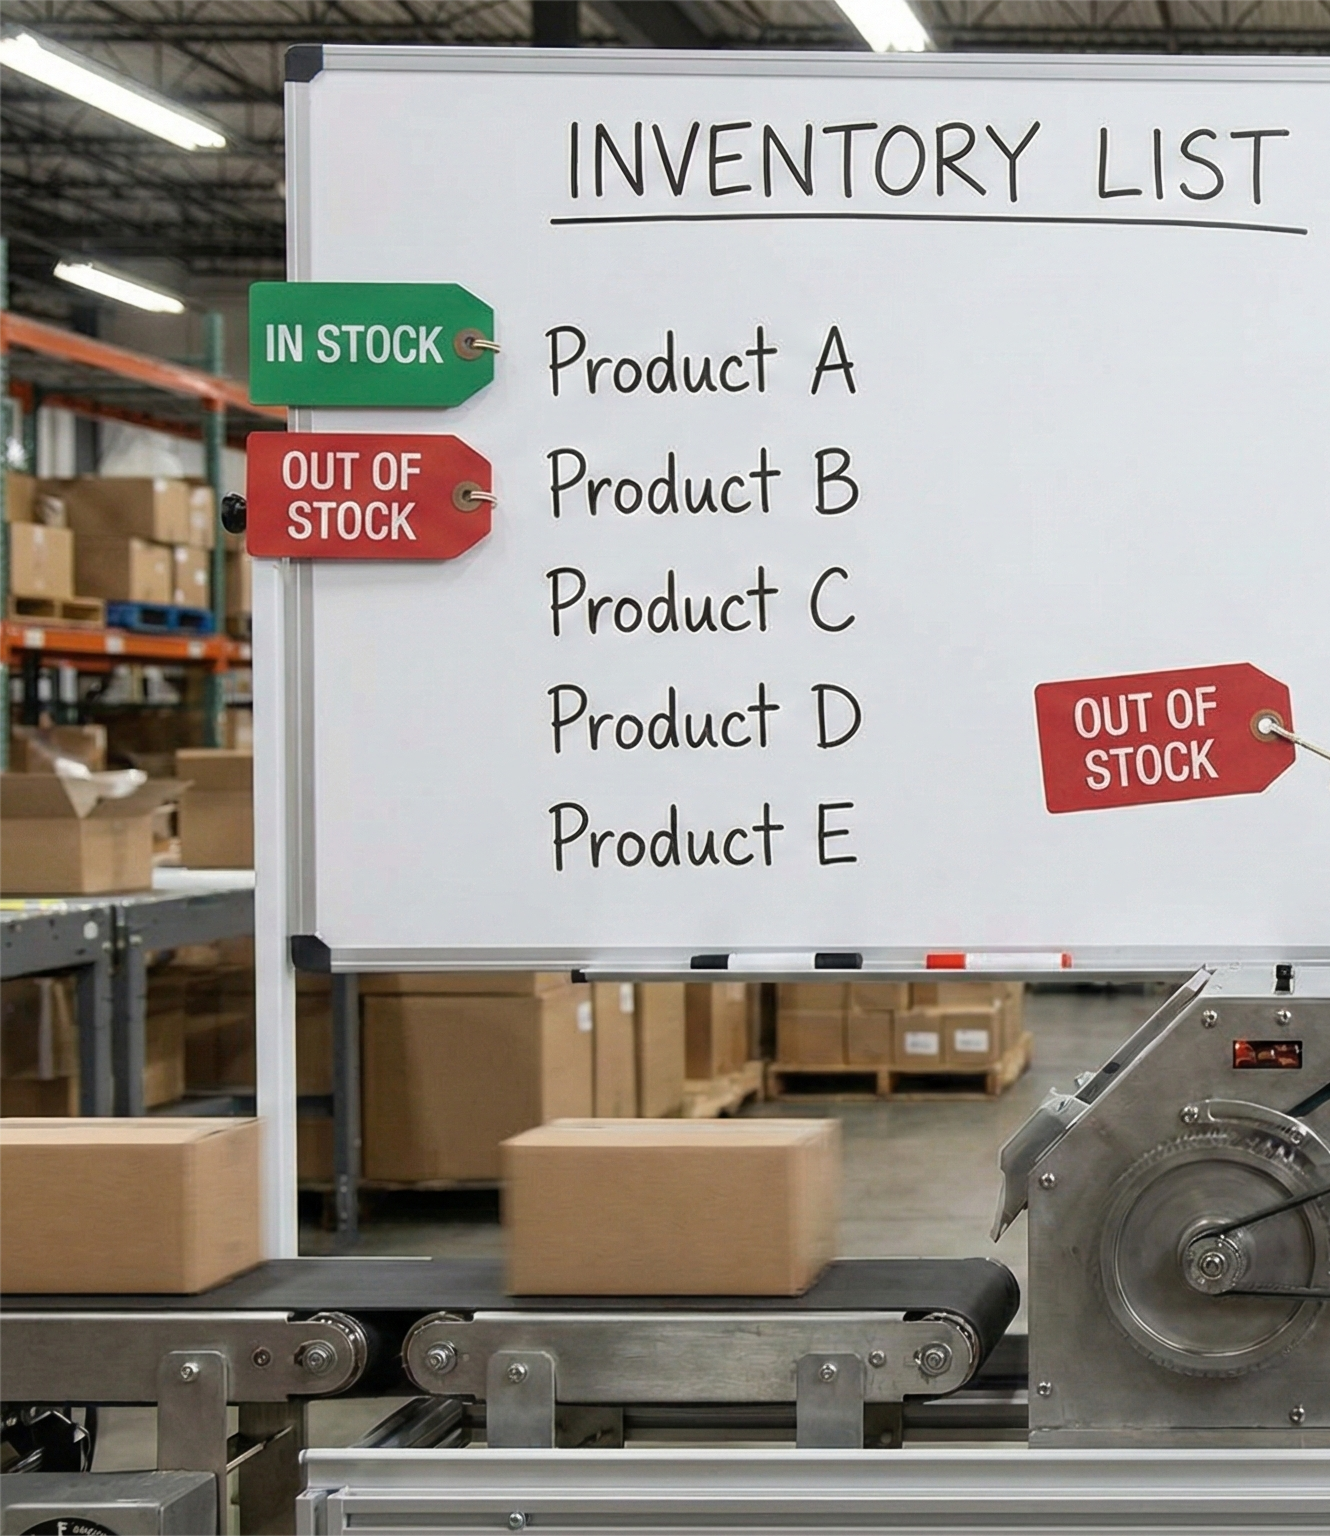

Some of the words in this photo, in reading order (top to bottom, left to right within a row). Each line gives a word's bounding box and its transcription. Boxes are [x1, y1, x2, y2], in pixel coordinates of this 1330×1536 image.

[570, 120, 1041, 203] INVENTORY
[1098, 127, 1290, 205] LIST
[266, 324, 303, 362] IN
[316, 323, 444, 364] STOCK
[545, 325, 778, 397] Product
[811, 325, 856, 395] A
[282, 450, 357, 490] OUT
[372, 451, 422, 491] OF
[546, 447, 781, 519] Product
[814, 447, 859, 515] B
[287, 500, 417, 541] STOCK
[545, 565, 779, 637] Product
[810, 566, 855, 632] C
[547, 682, 780, 754] Product
[810, 683, 862, 749] D
[1074, 691, 1153, 739] OUT
[1166, 685, 1217, 730] OF
[1084, 739, 1219, 790] STOCK
[548, 802, 785, 872] Product
[817, 802, 857, 866] E
